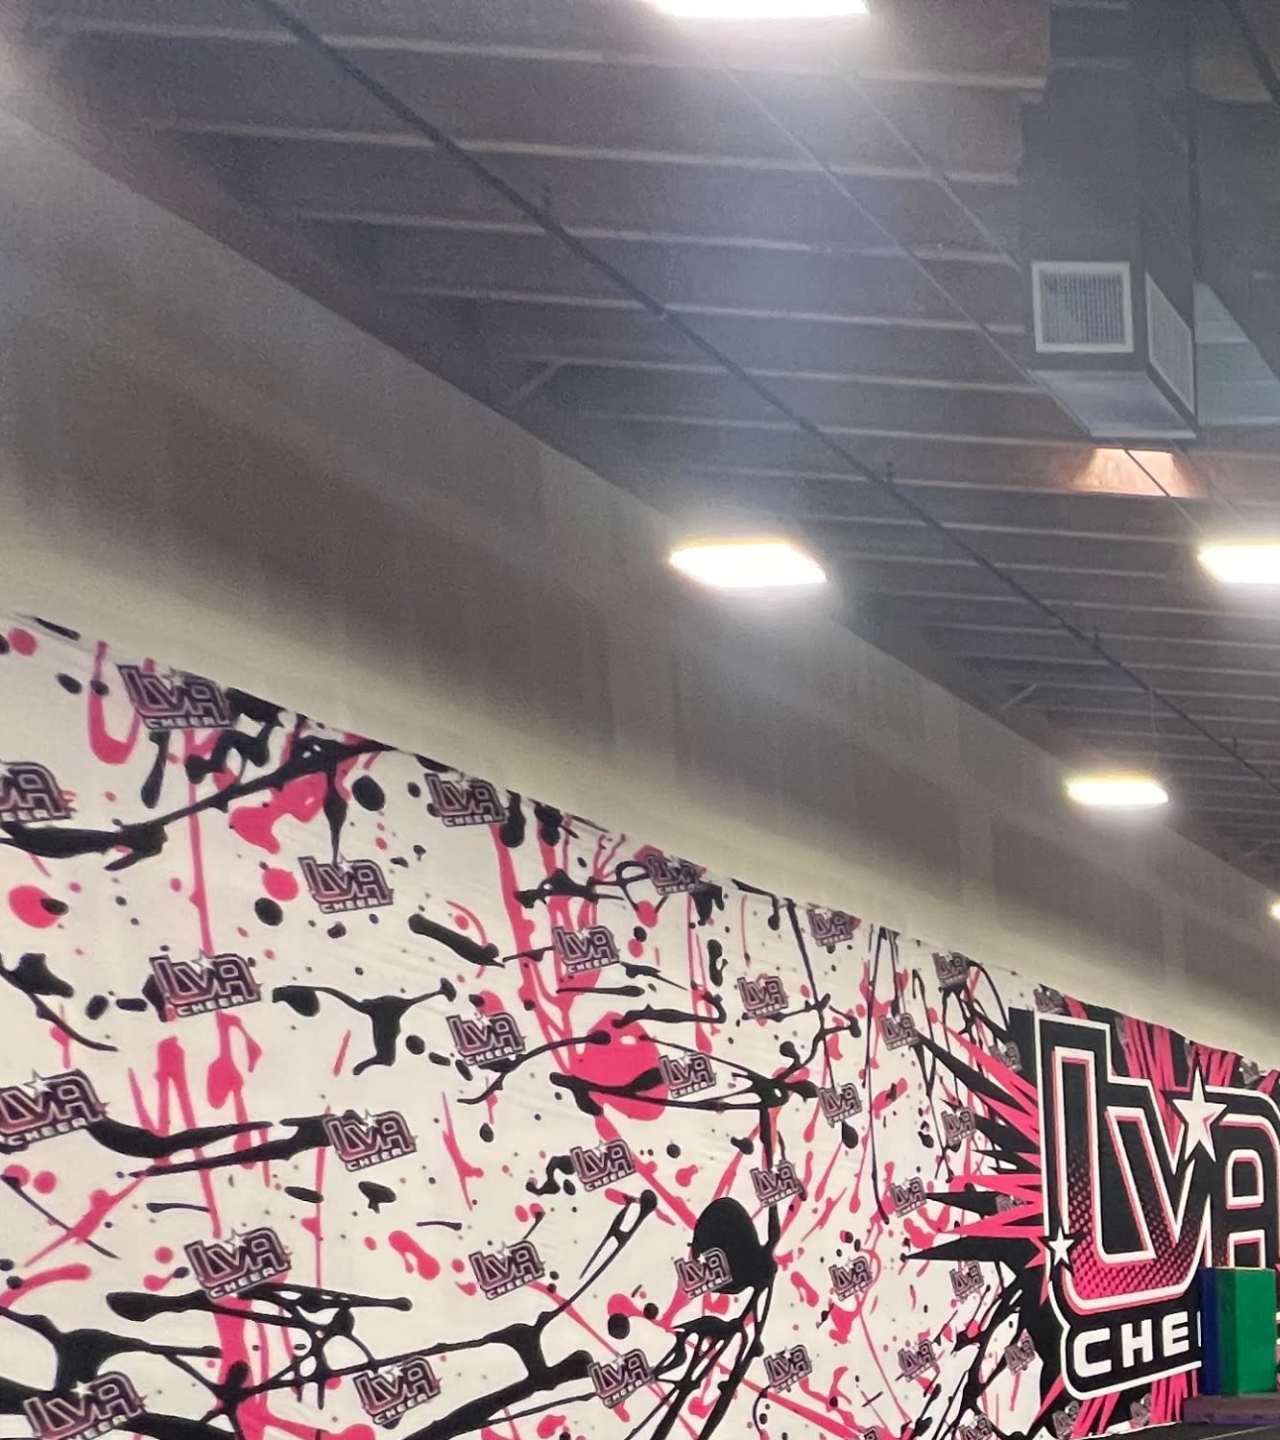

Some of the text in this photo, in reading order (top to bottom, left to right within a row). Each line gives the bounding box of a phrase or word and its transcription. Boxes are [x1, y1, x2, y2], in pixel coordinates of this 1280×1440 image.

[424, 773, 507, 821] LVA
[298, 857, 393, 904] LVA
[553, 925, 619, 965] LVA
[150, 953, 261, 1004] LVA
[447, 1012, 526, 1056] LVA
[660, 1053, 716, 1090] LVA
[323, 1111, 417, 1163] LVA
[570, 1140, 635, 1183] LVA
[183, 1228, 292, 1288] LVA
[469, 1241, 544, 1291] LVA
[675, 1248, 732, 1291] LVA
[1073, 1311, 1201, 1378] CHE
[353, 1357, 440, 1414] LVA
[588, 1349, 655, 1398] LVA
